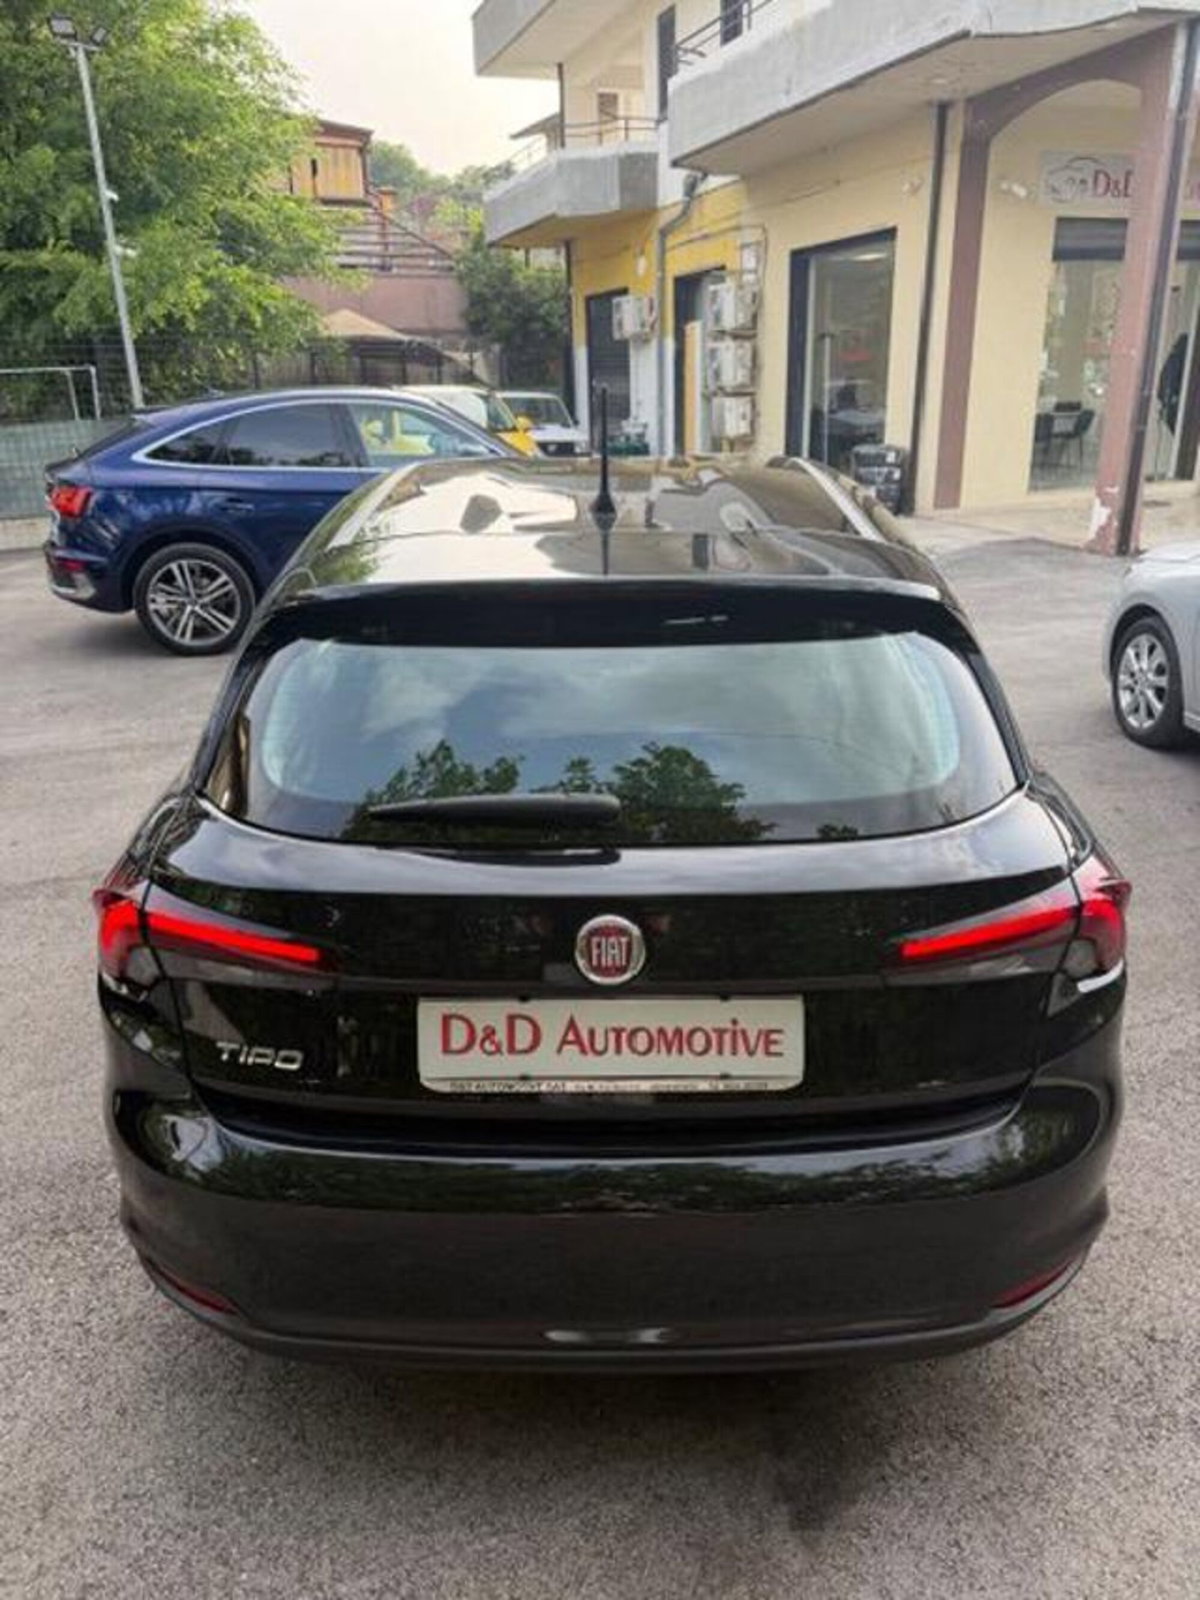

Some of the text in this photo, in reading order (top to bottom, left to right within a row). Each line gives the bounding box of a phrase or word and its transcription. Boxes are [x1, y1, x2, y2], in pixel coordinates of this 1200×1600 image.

[590, 935, 629, 967] FIAT
[440, 1013, 542, 1056] D&D
[215, 1040, 304, 1071] TIPO
